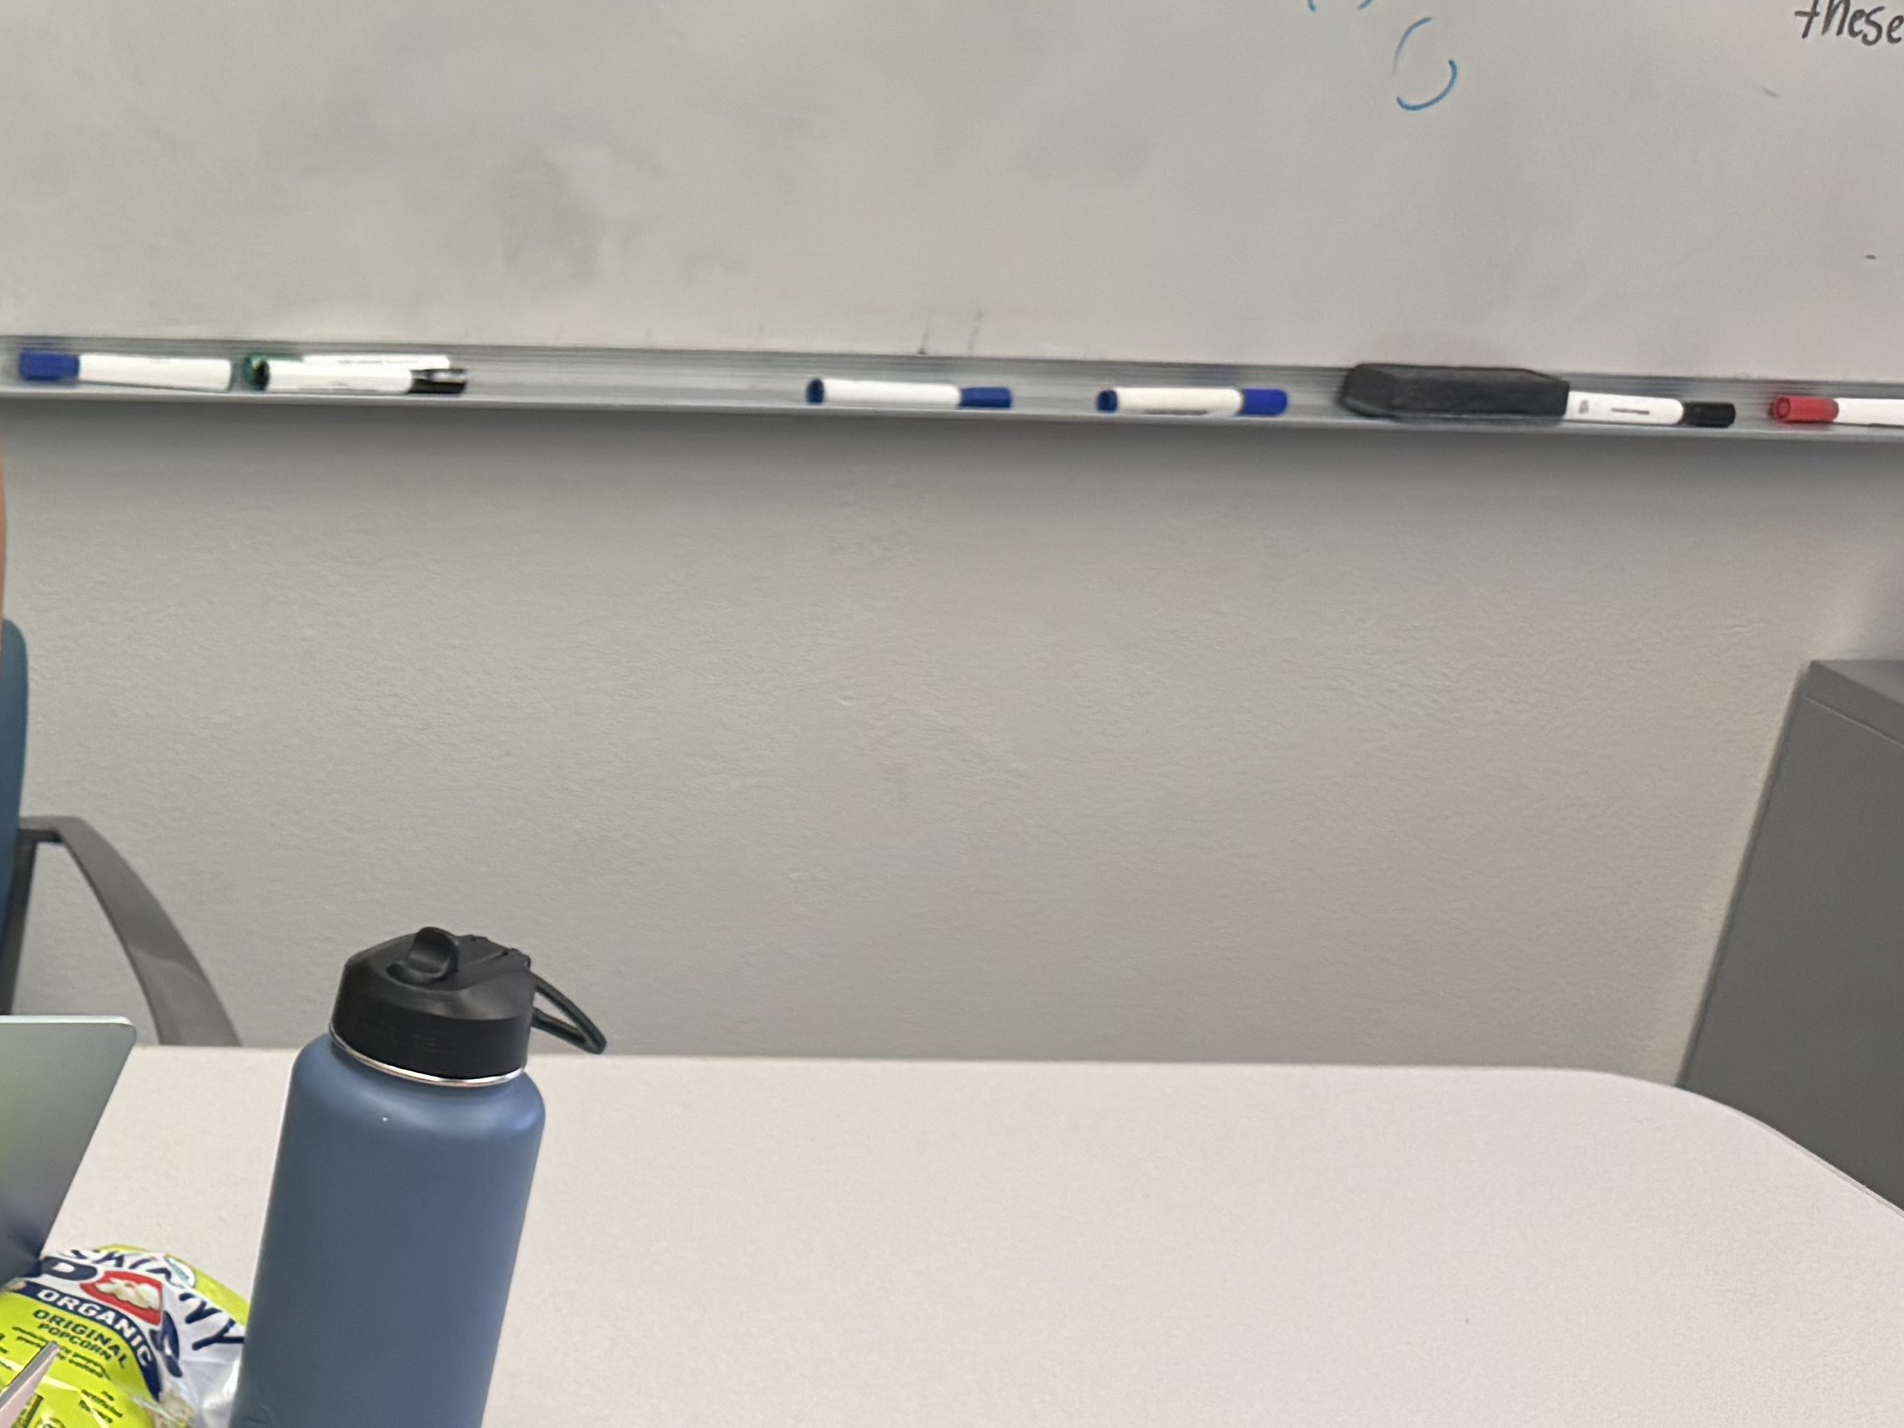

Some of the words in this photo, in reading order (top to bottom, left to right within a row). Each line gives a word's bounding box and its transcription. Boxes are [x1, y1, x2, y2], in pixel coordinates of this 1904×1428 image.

[32, 1307, 128, 1370] ORIGINAL
[36, 1287, 155, 1369] ORGANIC
[37, 1322, 114, 1362] POPCORN
